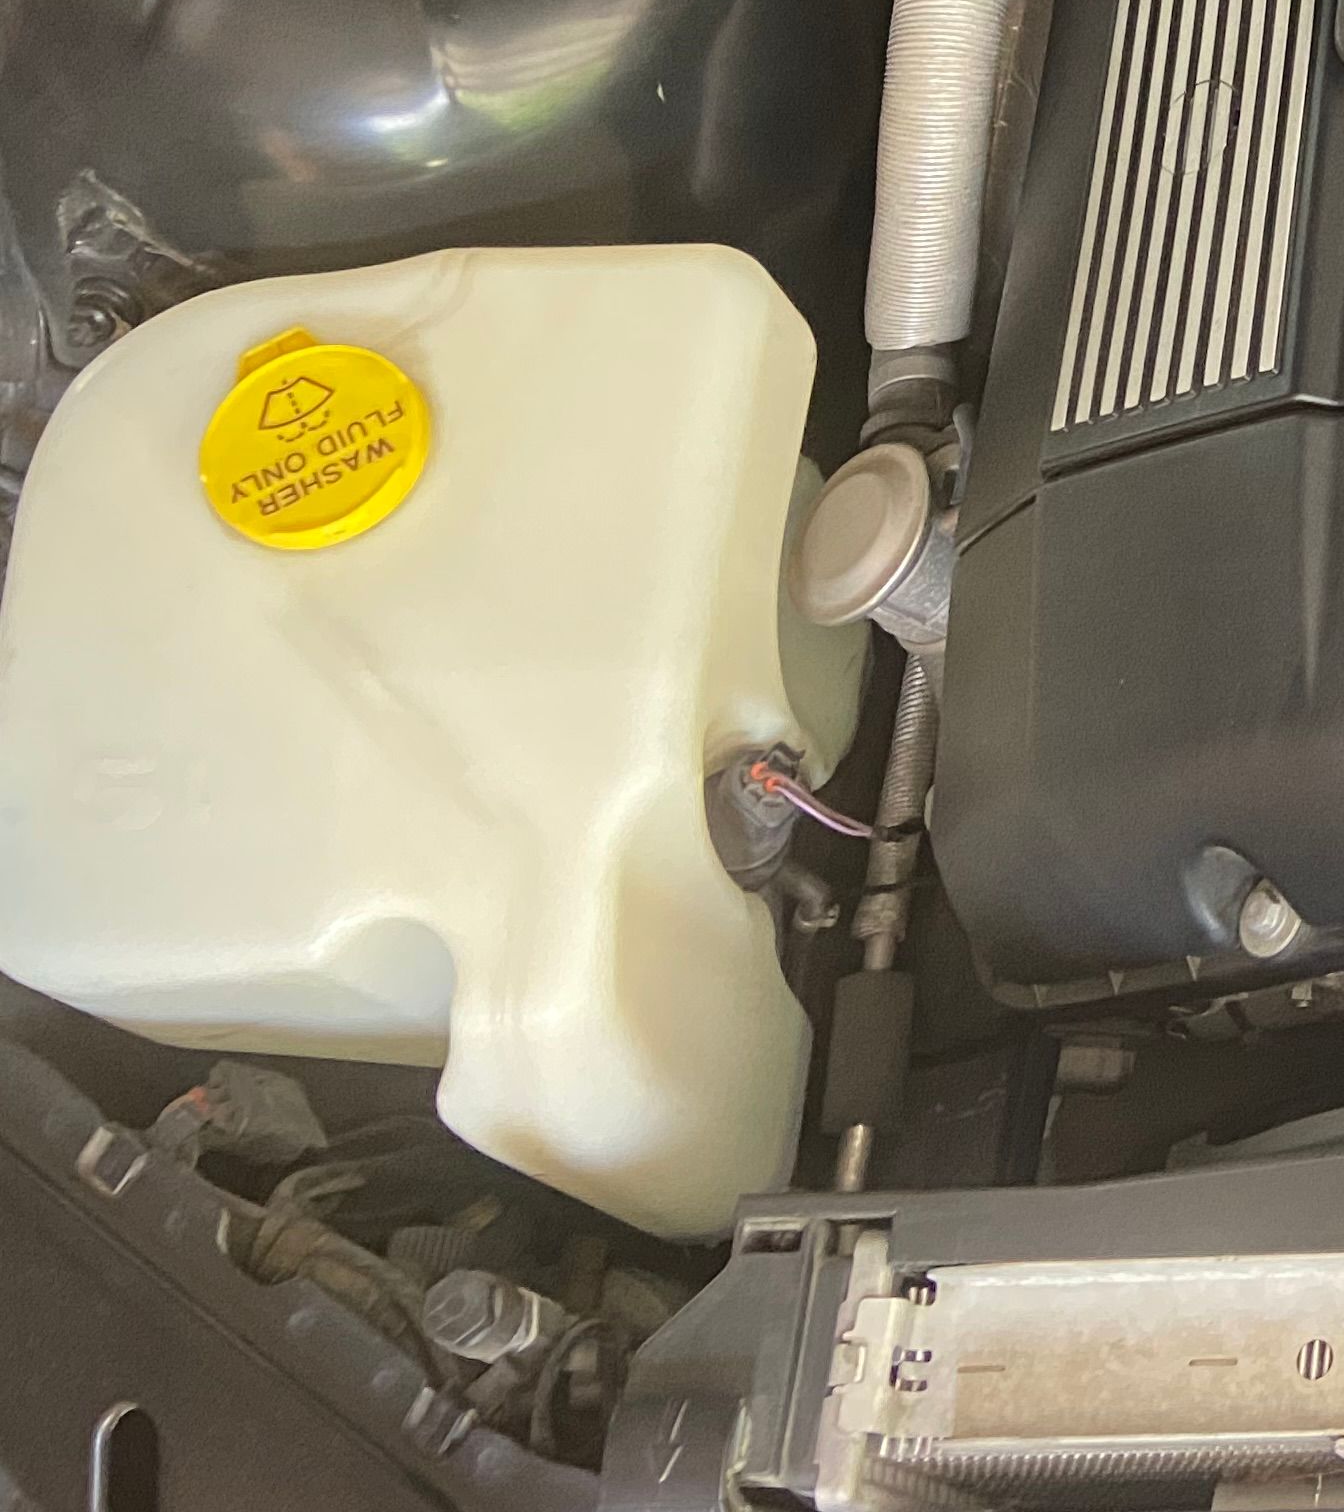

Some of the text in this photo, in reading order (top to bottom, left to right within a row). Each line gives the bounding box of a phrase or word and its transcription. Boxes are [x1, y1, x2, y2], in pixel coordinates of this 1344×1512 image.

[231, 401, 405, 503] FLUID ONLY
[257, 437, 396, 516] WASHER
